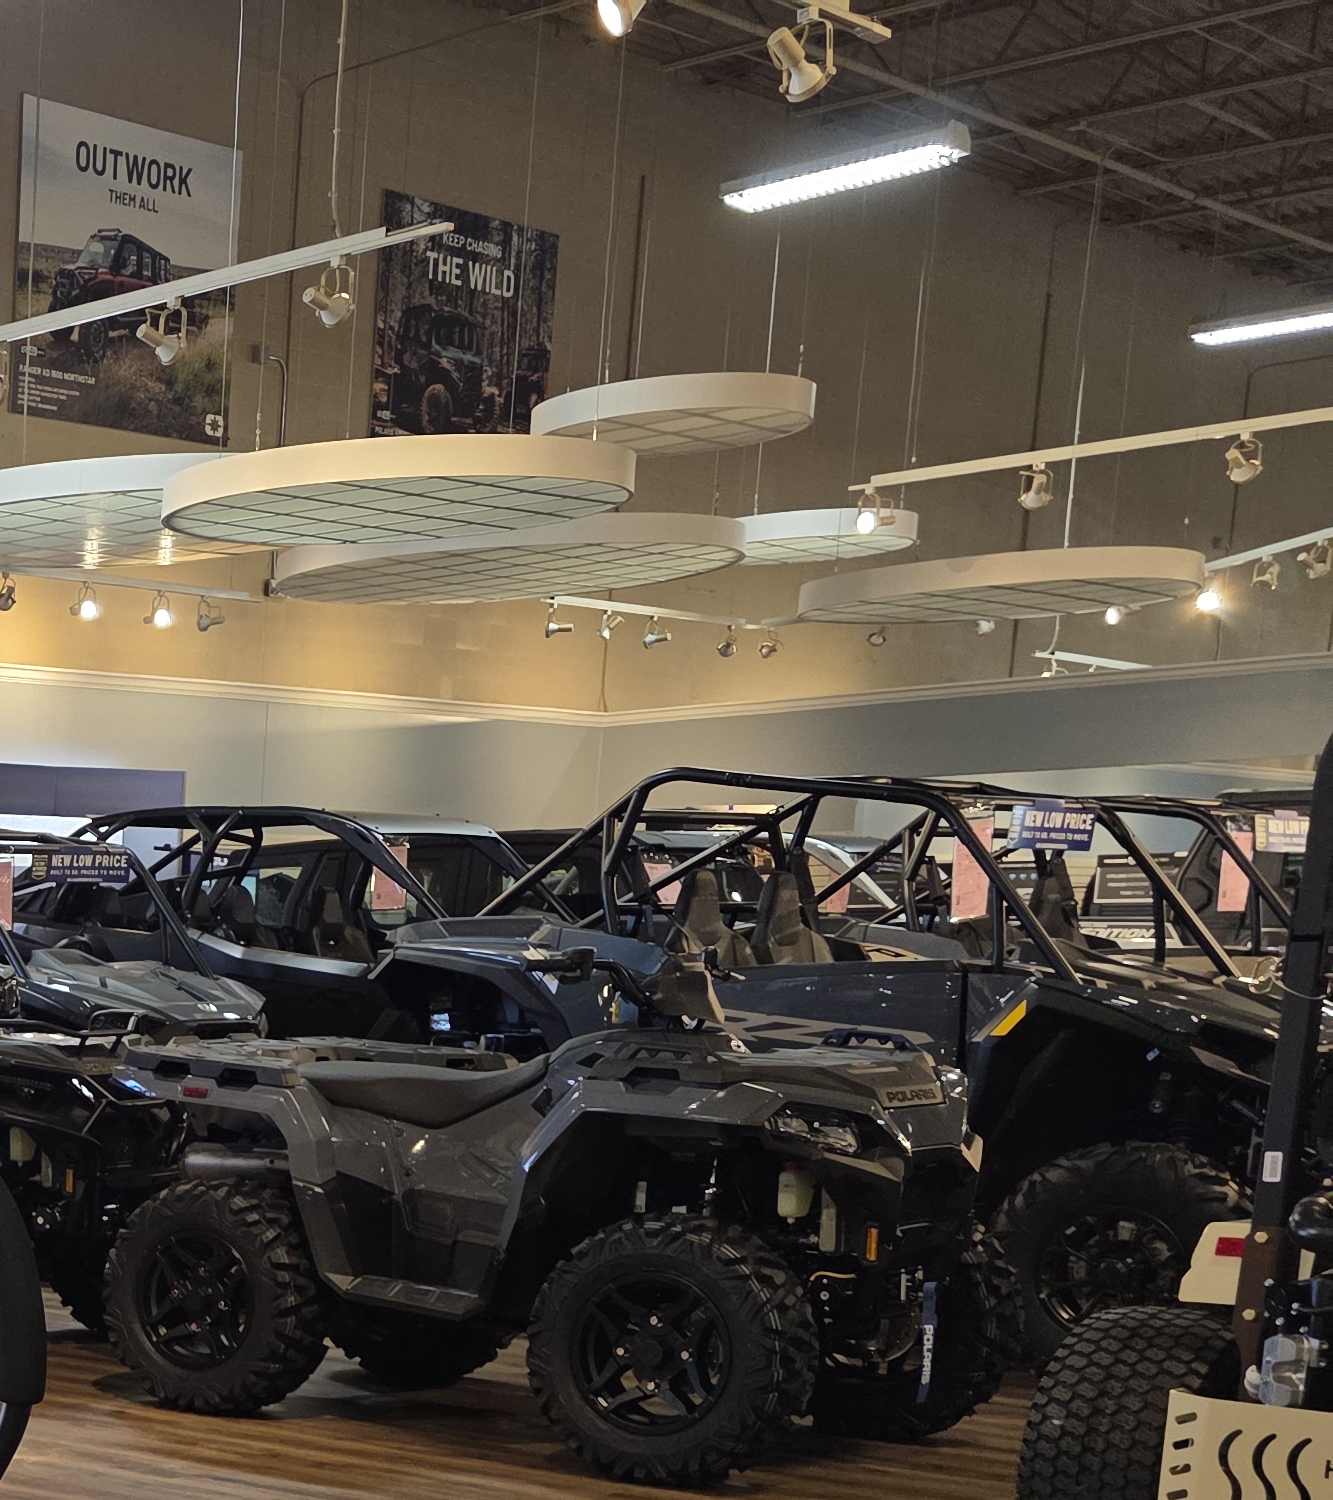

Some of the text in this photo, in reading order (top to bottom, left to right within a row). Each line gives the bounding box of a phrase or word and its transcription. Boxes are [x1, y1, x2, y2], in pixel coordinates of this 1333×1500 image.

[75, 140, 193, 198] OUTWORK
[108, 188, 160, 214] THEM ALL
[441, 231, 503, 259] KEEP CHASING
[426, 251, 515, 298] THE WILD
[1043, 811, 1064, 829] LOW
[1064, 812, 1094, 830] PRICE
[51, 854, 129, 868] NEW LOW PRICE
[886, 1088, 937, 1103] POLARIS
